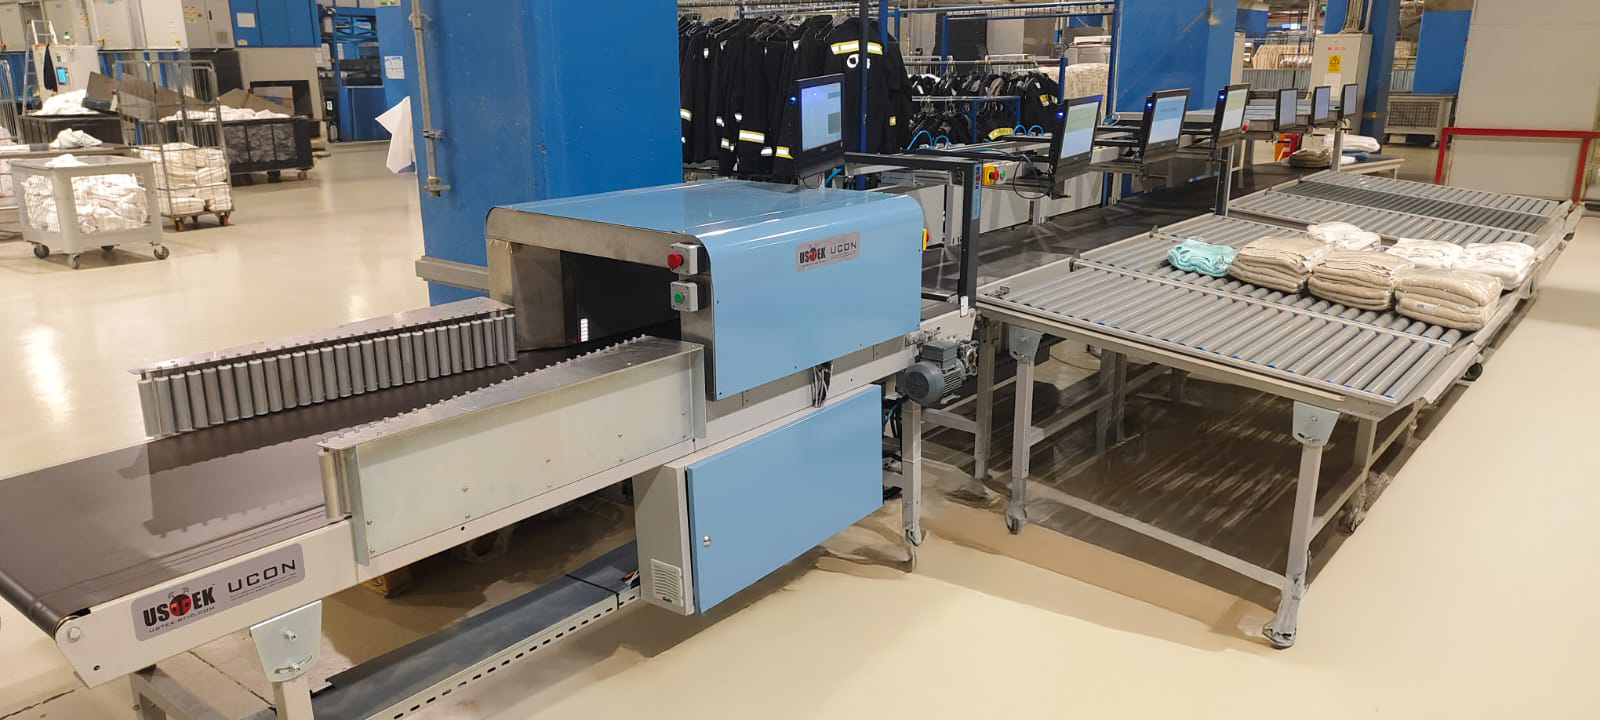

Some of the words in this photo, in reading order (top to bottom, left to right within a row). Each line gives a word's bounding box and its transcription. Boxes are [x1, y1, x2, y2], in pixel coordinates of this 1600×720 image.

[830, 241, 857, 255] UCON
[143, 586, 216, 627] USTEK
[228, 559, 296, 593] UCON
